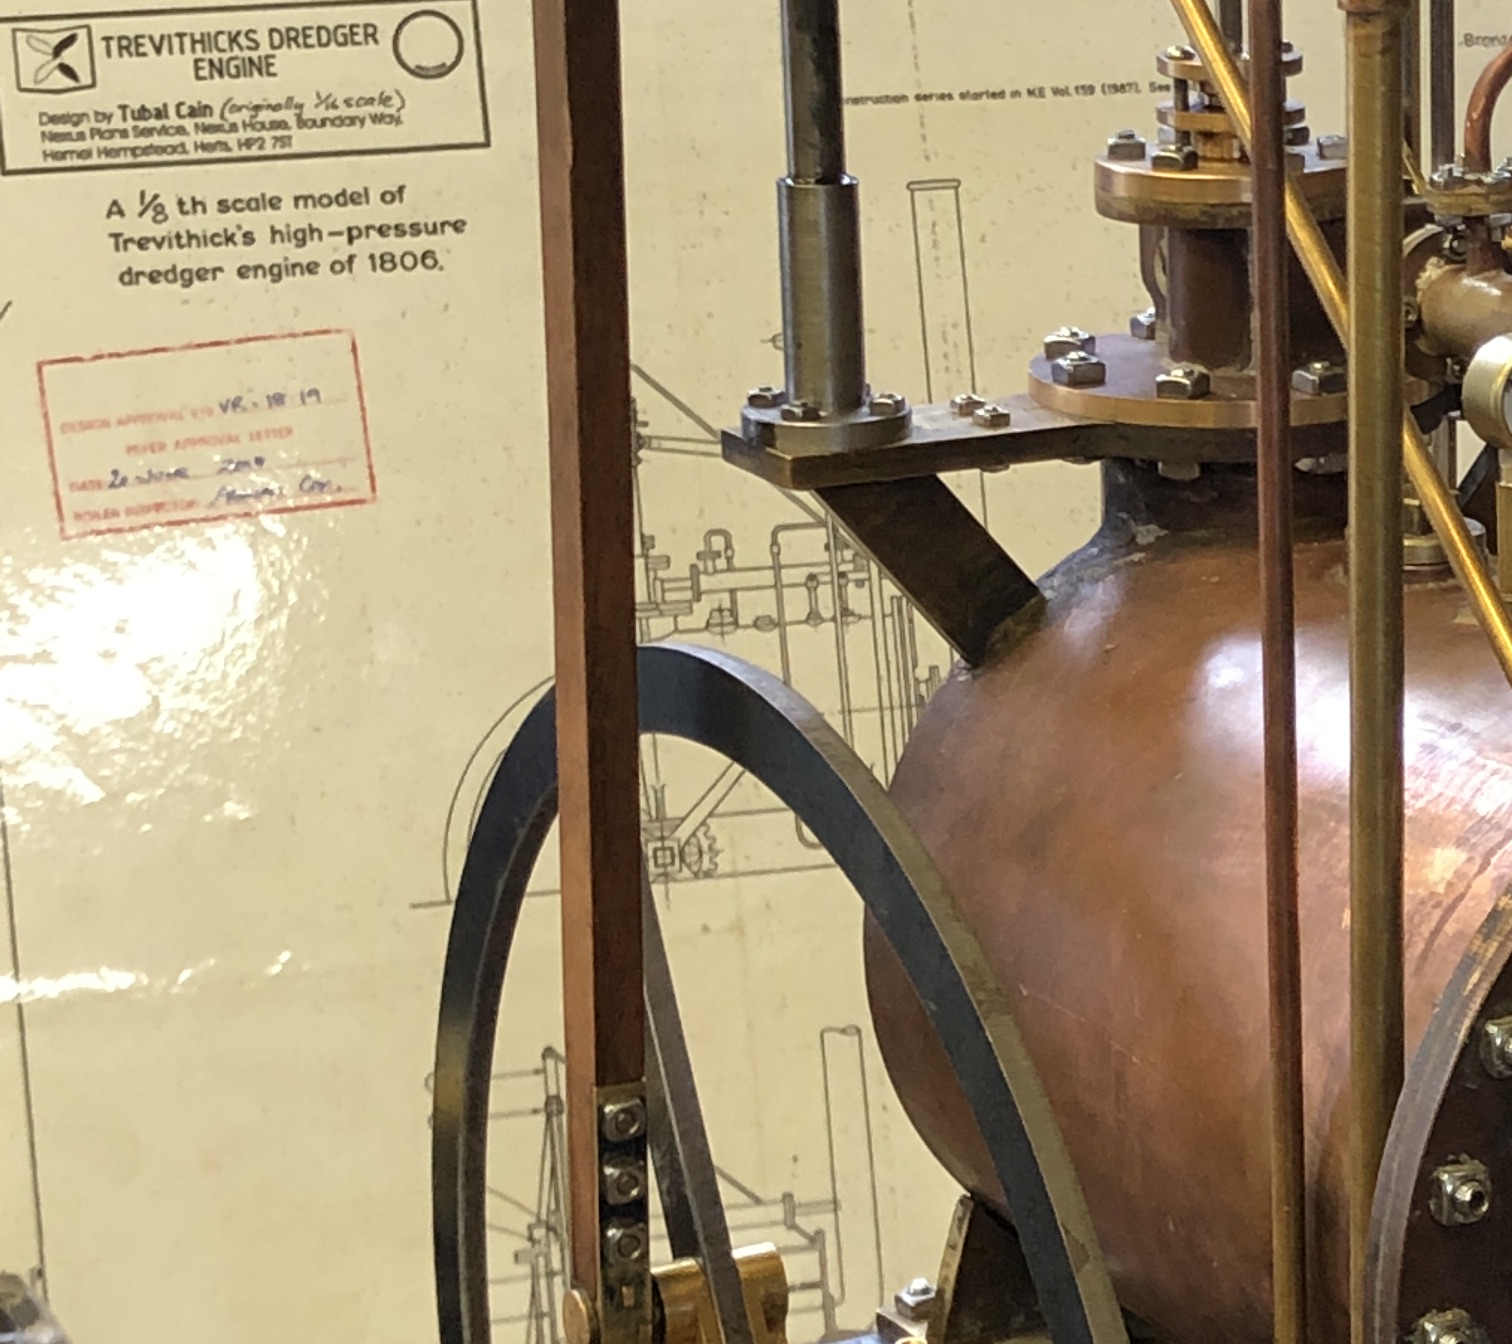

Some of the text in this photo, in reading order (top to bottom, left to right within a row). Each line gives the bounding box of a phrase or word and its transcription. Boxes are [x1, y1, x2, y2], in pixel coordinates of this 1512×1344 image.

[101, 23, 380, 59] TREVITHICKS DREDGER
[193, 54, 279, 81] ENGINE
[219, 95, 305, 122] (originally
[343, 88, 407, 113] scale)
[914, 91, 954, 103] series
[959, 88, 1006, 101] started
[38, 101, 214, 127] Design by Tubal Cain
[41, 128, 87, 144] Nexus
[90, 126, 130, 141] Plans
[194, 120, 239, 135] Nexus
[42, 147, 93, 163] Hemel
[237, 135, 267, 151] HP2
[105, 198, 127, 220] A
[176, 194, 208, 216] th
[216, 191, 283, 215] scale
[293, 185, 371, 210] model
[380, 183, 407, 205] of
[108, 223, 257, 254] Trevithick's
[118, 249, 445, 289] dredger engine of 1806.
